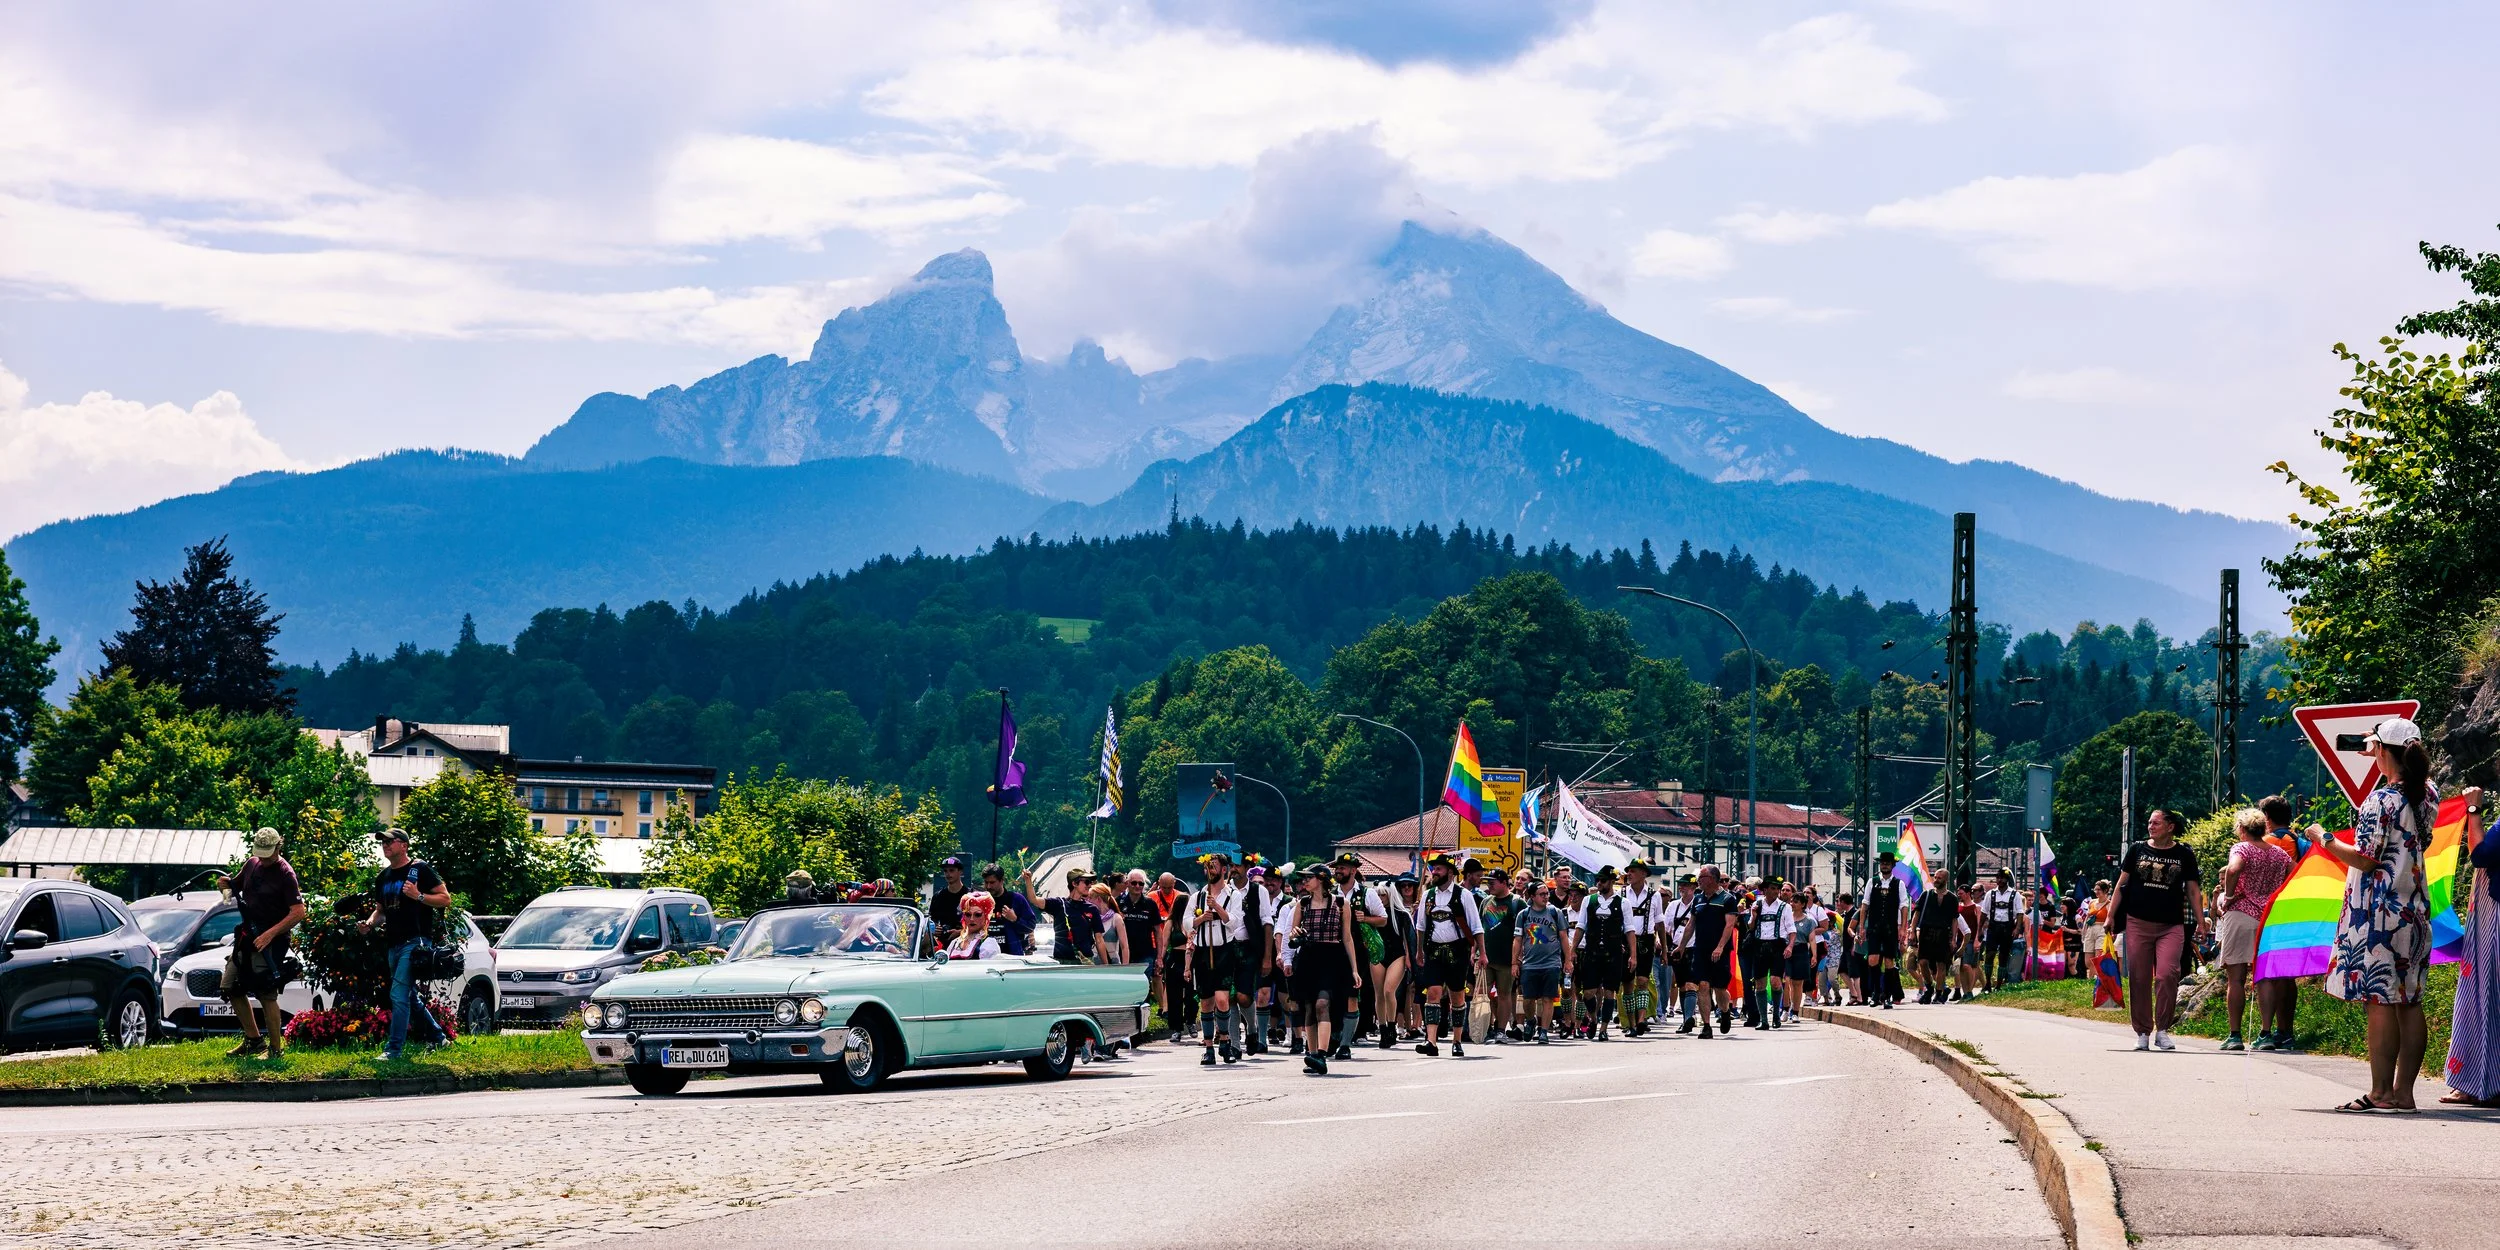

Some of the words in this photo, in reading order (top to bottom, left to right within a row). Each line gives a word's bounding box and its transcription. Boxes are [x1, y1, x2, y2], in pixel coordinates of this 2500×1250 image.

[1562, 806, 1578, 831] you
[1586, 823, 1605, 835] Verein
[1605, 830, 1615, 839] für
[1584, 831, 1631, 853] Angelegenheiten
[1878, 835, 1897, 844] BayW
[2147, 856, 2182, 865] MACHINE
[520, 998, 534, 1006] 153
[205, 1005, 213, 1014] IN
[217, 1005, 227, 1014] MP
[669, 1050, 685, 1063] REI
[692, 1050, 705, 1063] DU
[706, 1050, 726, 1063] 61H
